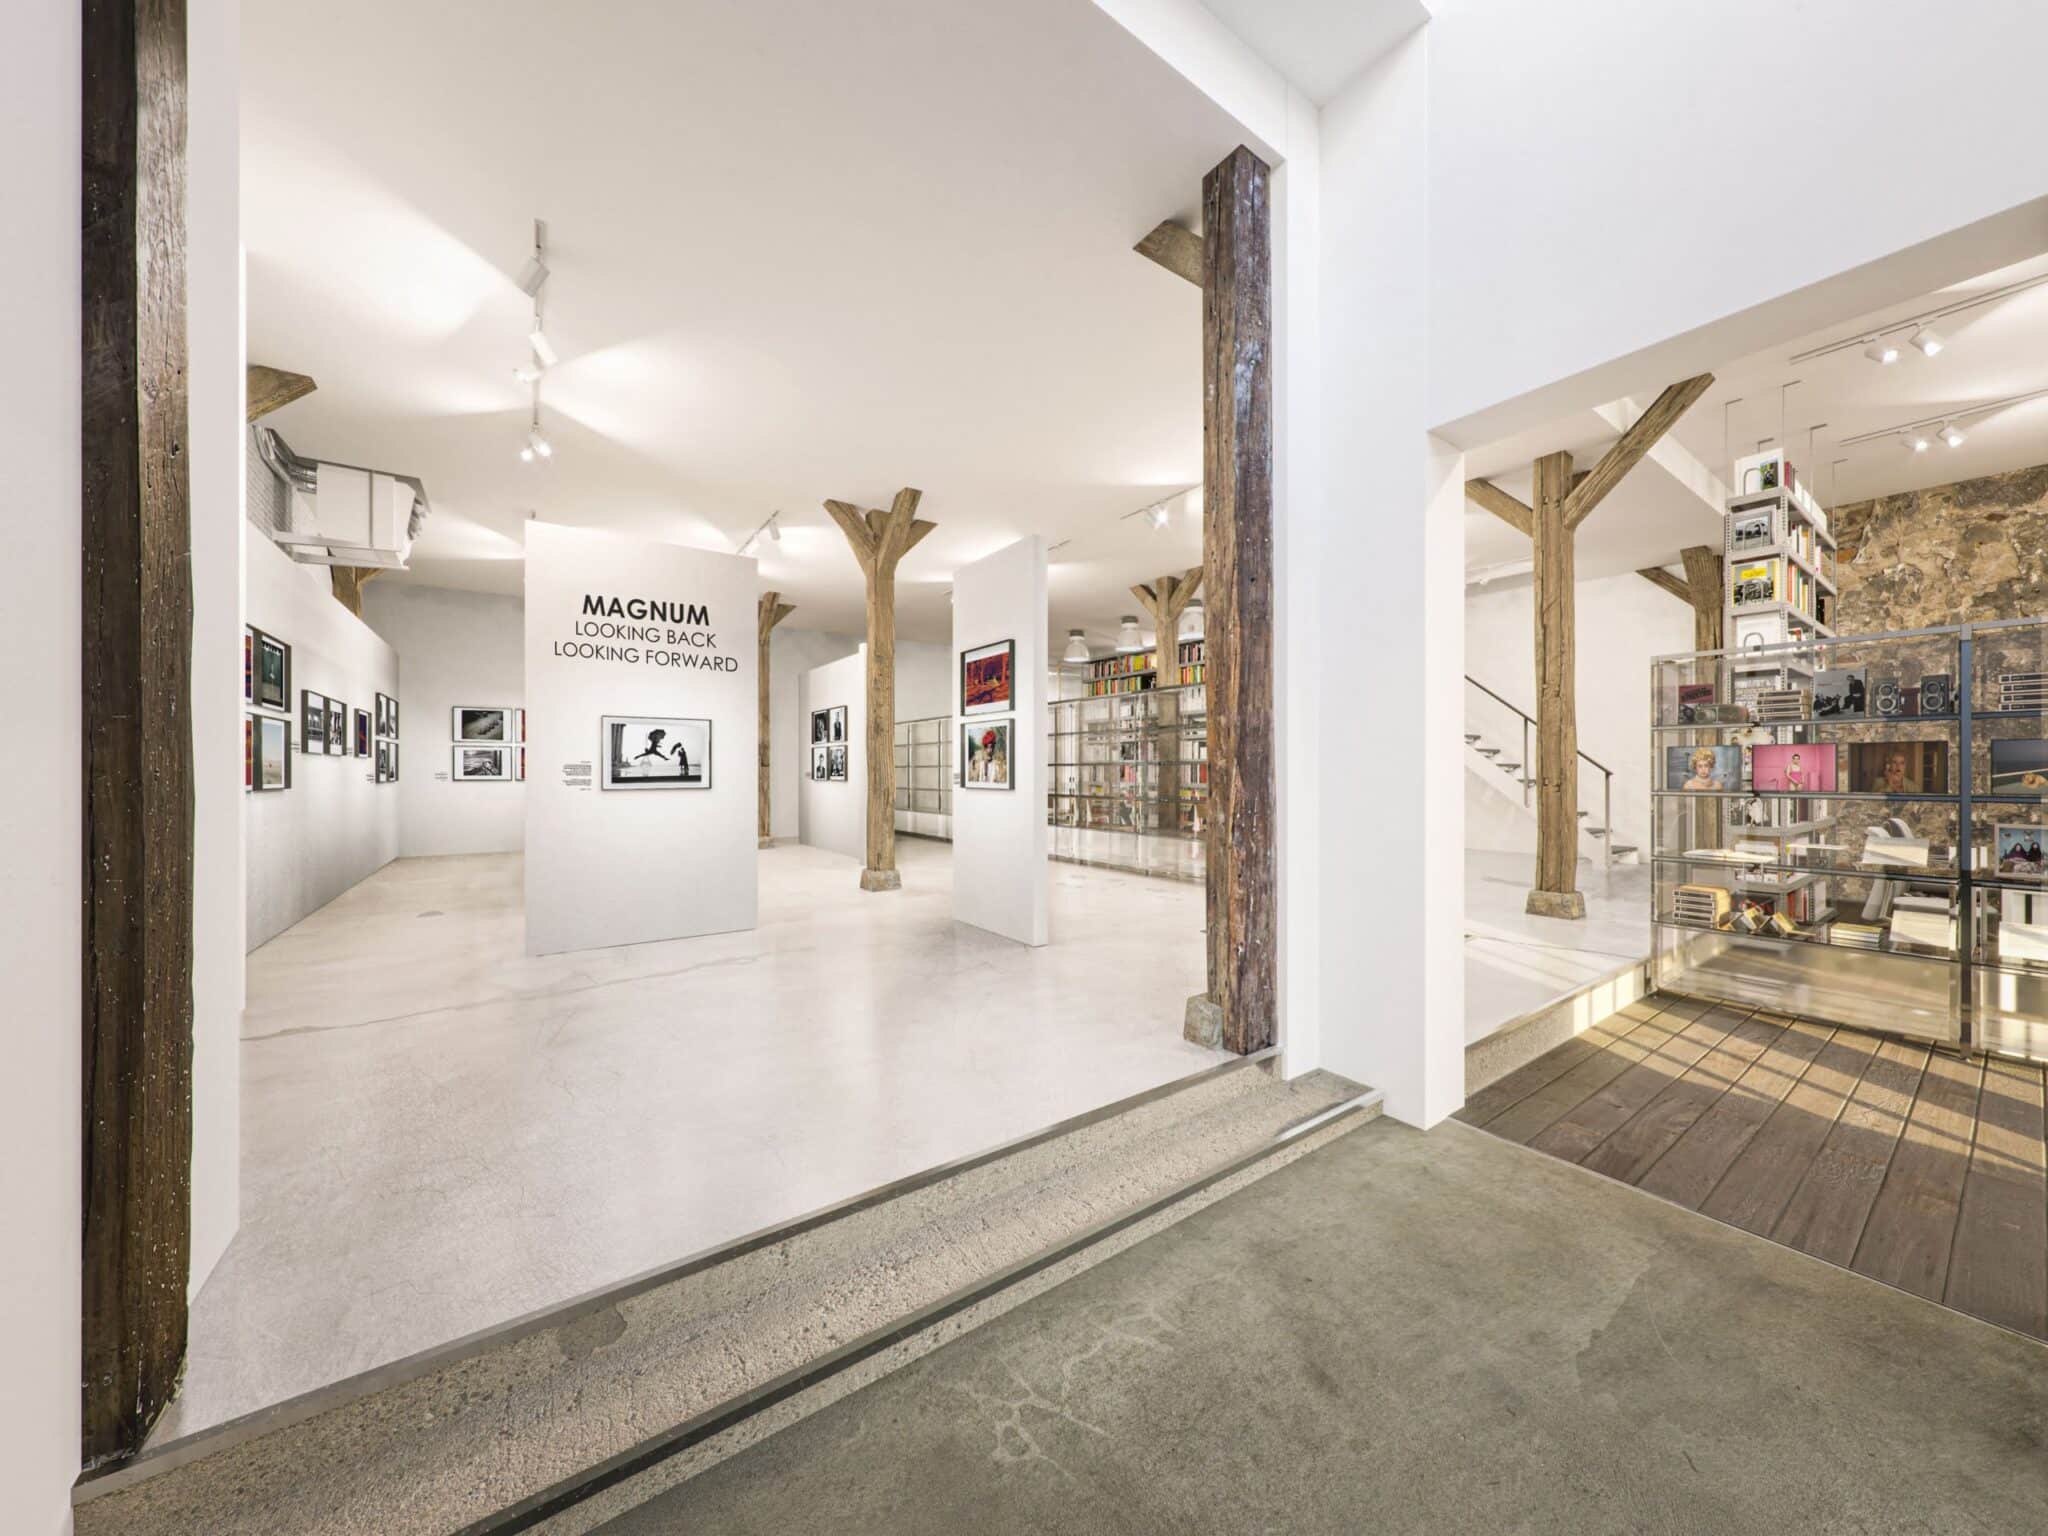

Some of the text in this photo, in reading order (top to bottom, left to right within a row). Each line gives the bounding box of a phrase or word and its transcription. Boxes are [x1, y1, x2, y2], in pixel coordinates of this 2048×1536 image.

[582, 594, 710, 626] MAGNUM
[575, 620, 717, 648] LOOKING BACK
[554, 641, 738, 672] LOOKING FORWARD
